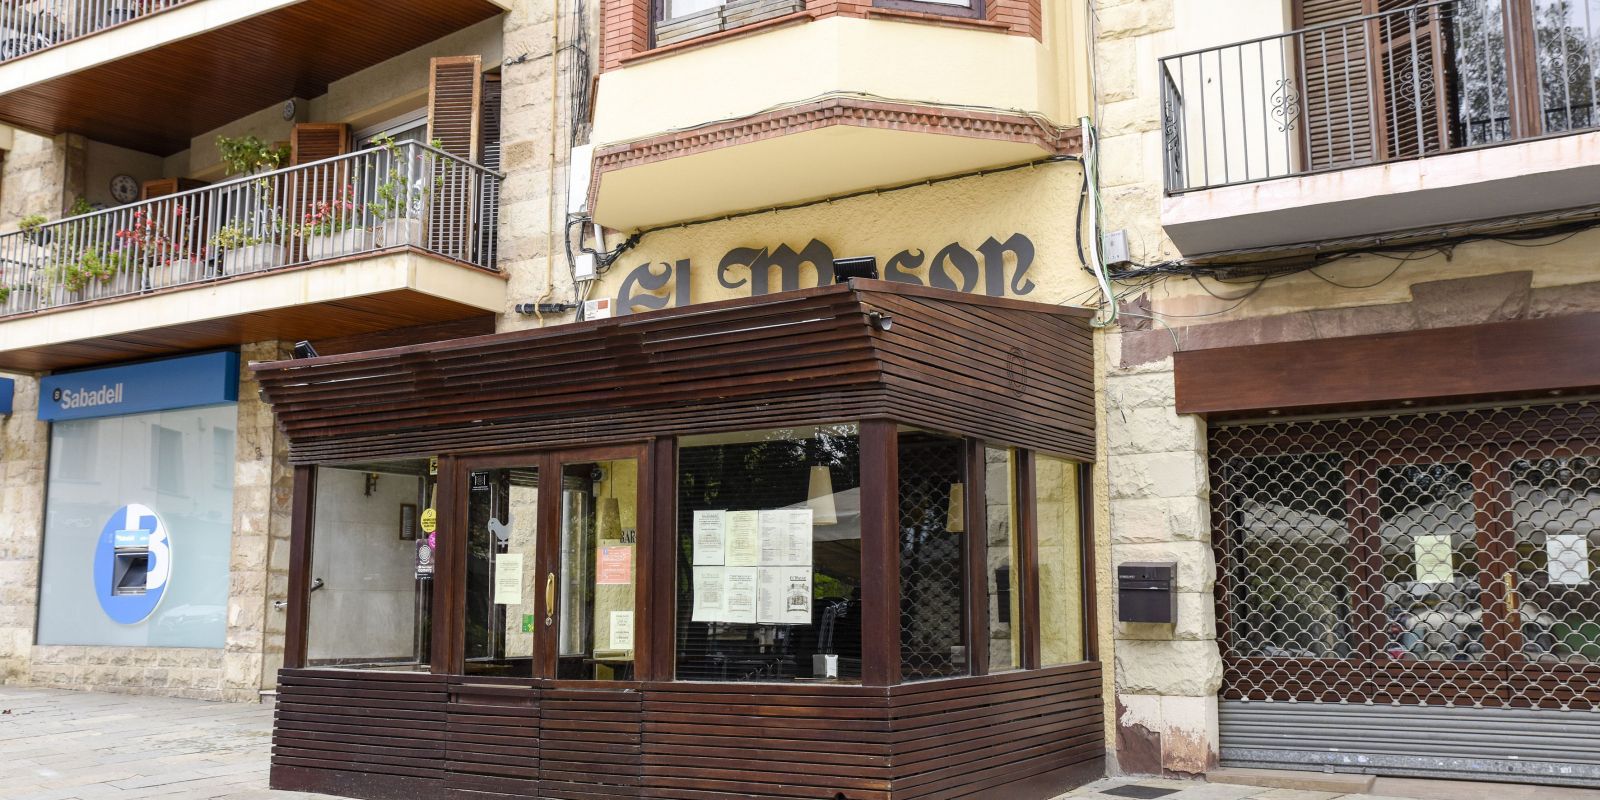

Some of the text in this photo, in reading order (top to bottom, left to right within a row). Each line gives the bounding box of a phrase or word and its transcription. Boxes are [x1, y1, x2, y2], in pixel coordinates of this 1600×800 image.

[616, 233, 1035, 313] El Mson
[61, 383, 123, 409] Sabadell
